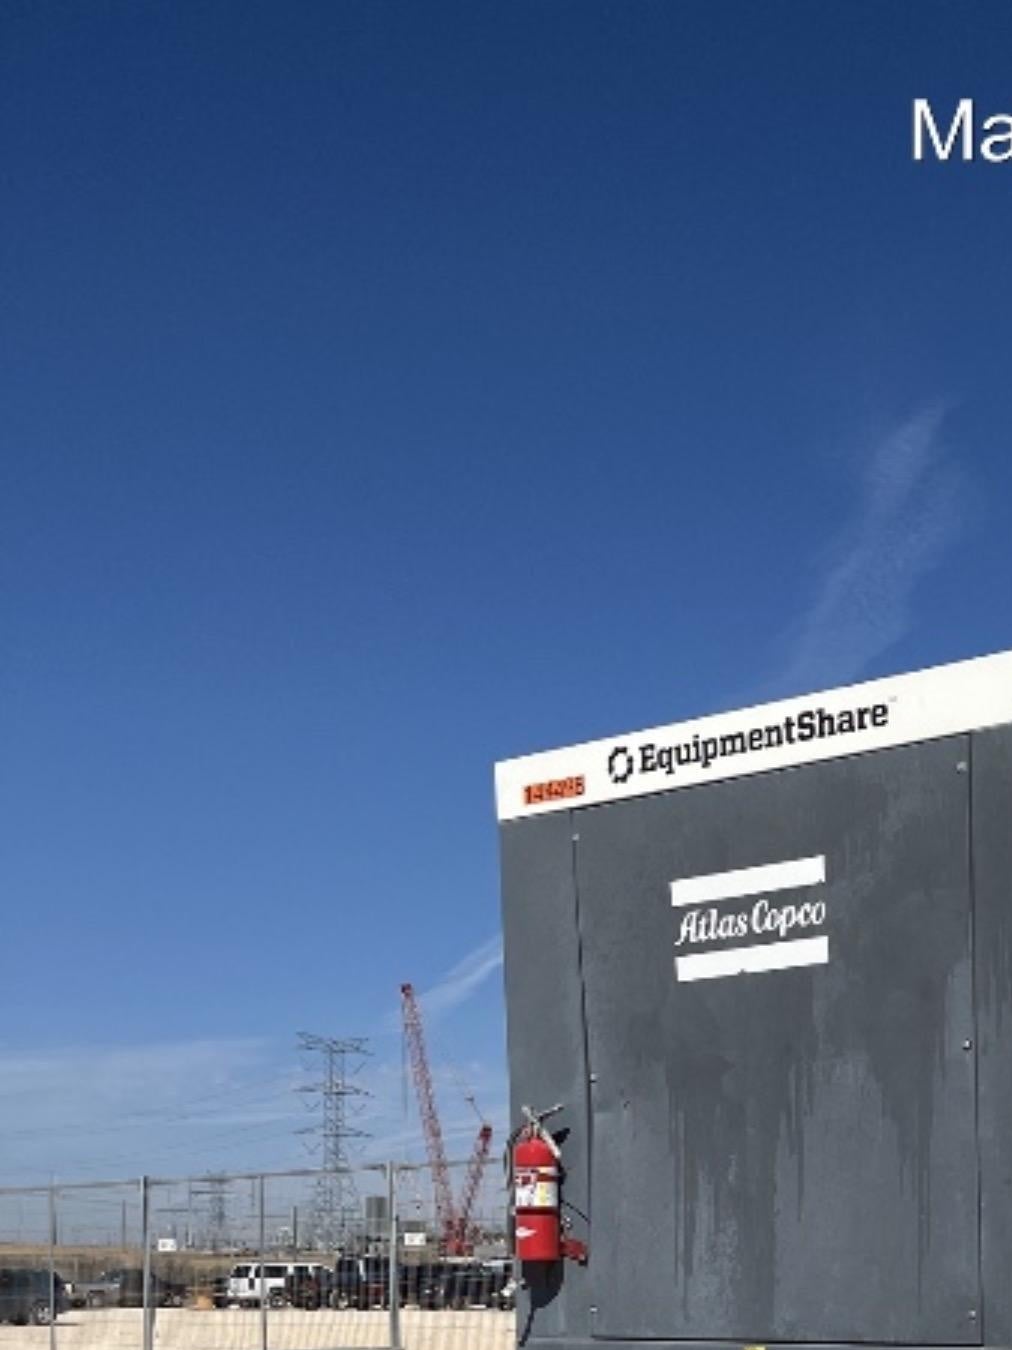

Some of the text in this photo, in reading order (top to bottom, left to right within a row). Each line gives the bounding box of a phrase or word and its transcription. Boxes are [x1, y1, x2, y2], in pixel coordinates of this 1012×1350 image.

[638, 701, 890, 776] EquipmentShare
[673, 899, 827, 946] Atlas Copco
